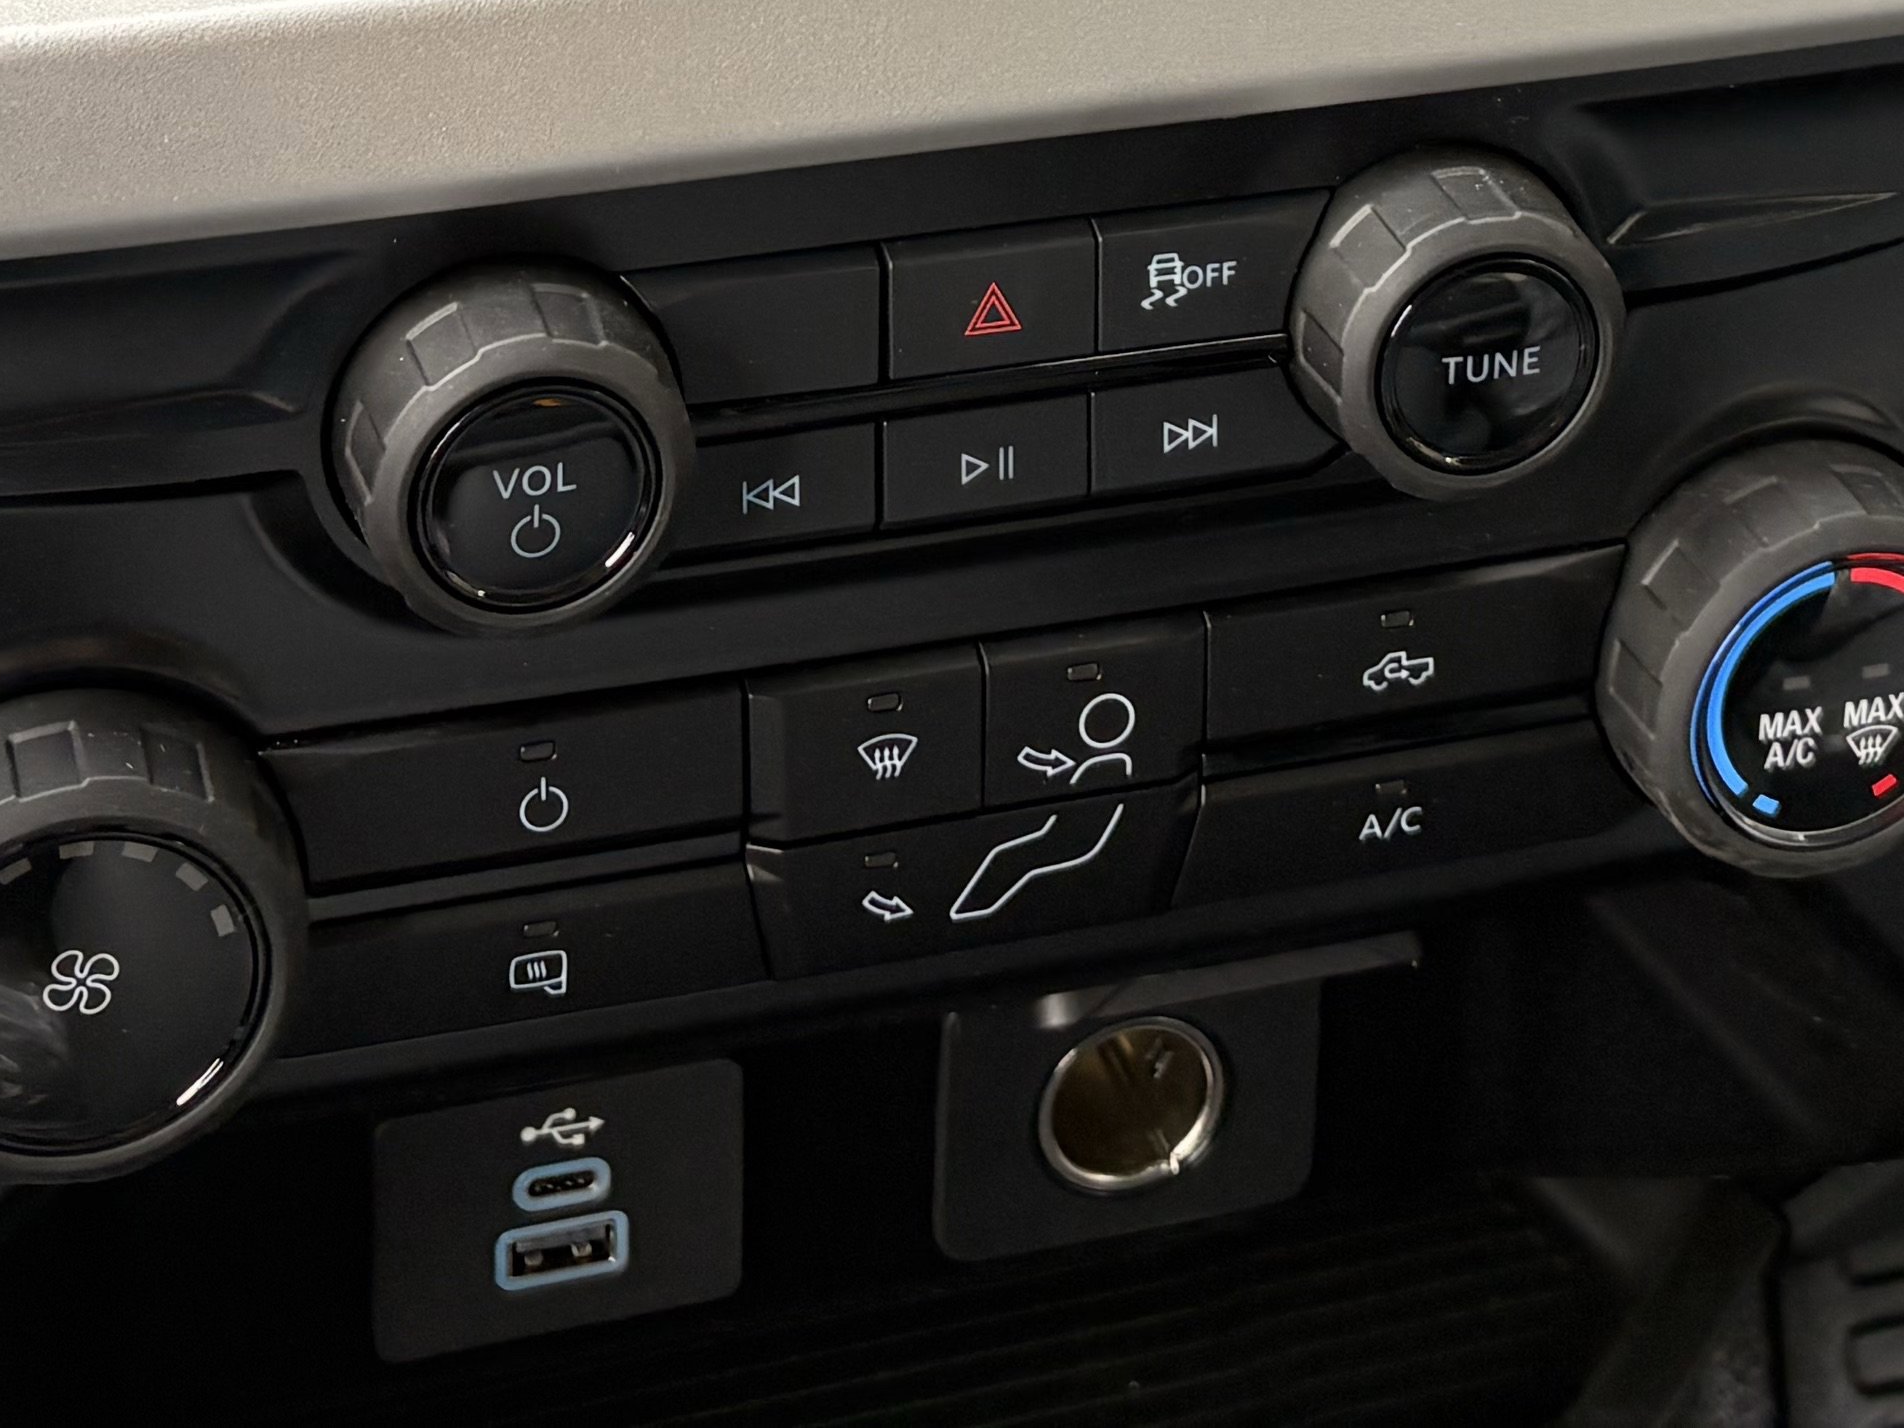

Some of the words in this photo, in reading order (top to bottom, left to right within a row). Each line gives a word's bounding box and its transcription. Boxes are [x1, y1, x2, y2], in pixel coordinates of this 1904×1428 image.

[1181, 259, 1237, 291] OFF
[1441, 345, 1542, 386] TUNE
[492, 461, 577, 502] VOL
[1758, 705, 1823, 740] MAX
[1763, 736, 1817, 771] A/C
[1359, 805, 1423, 842] A/C
